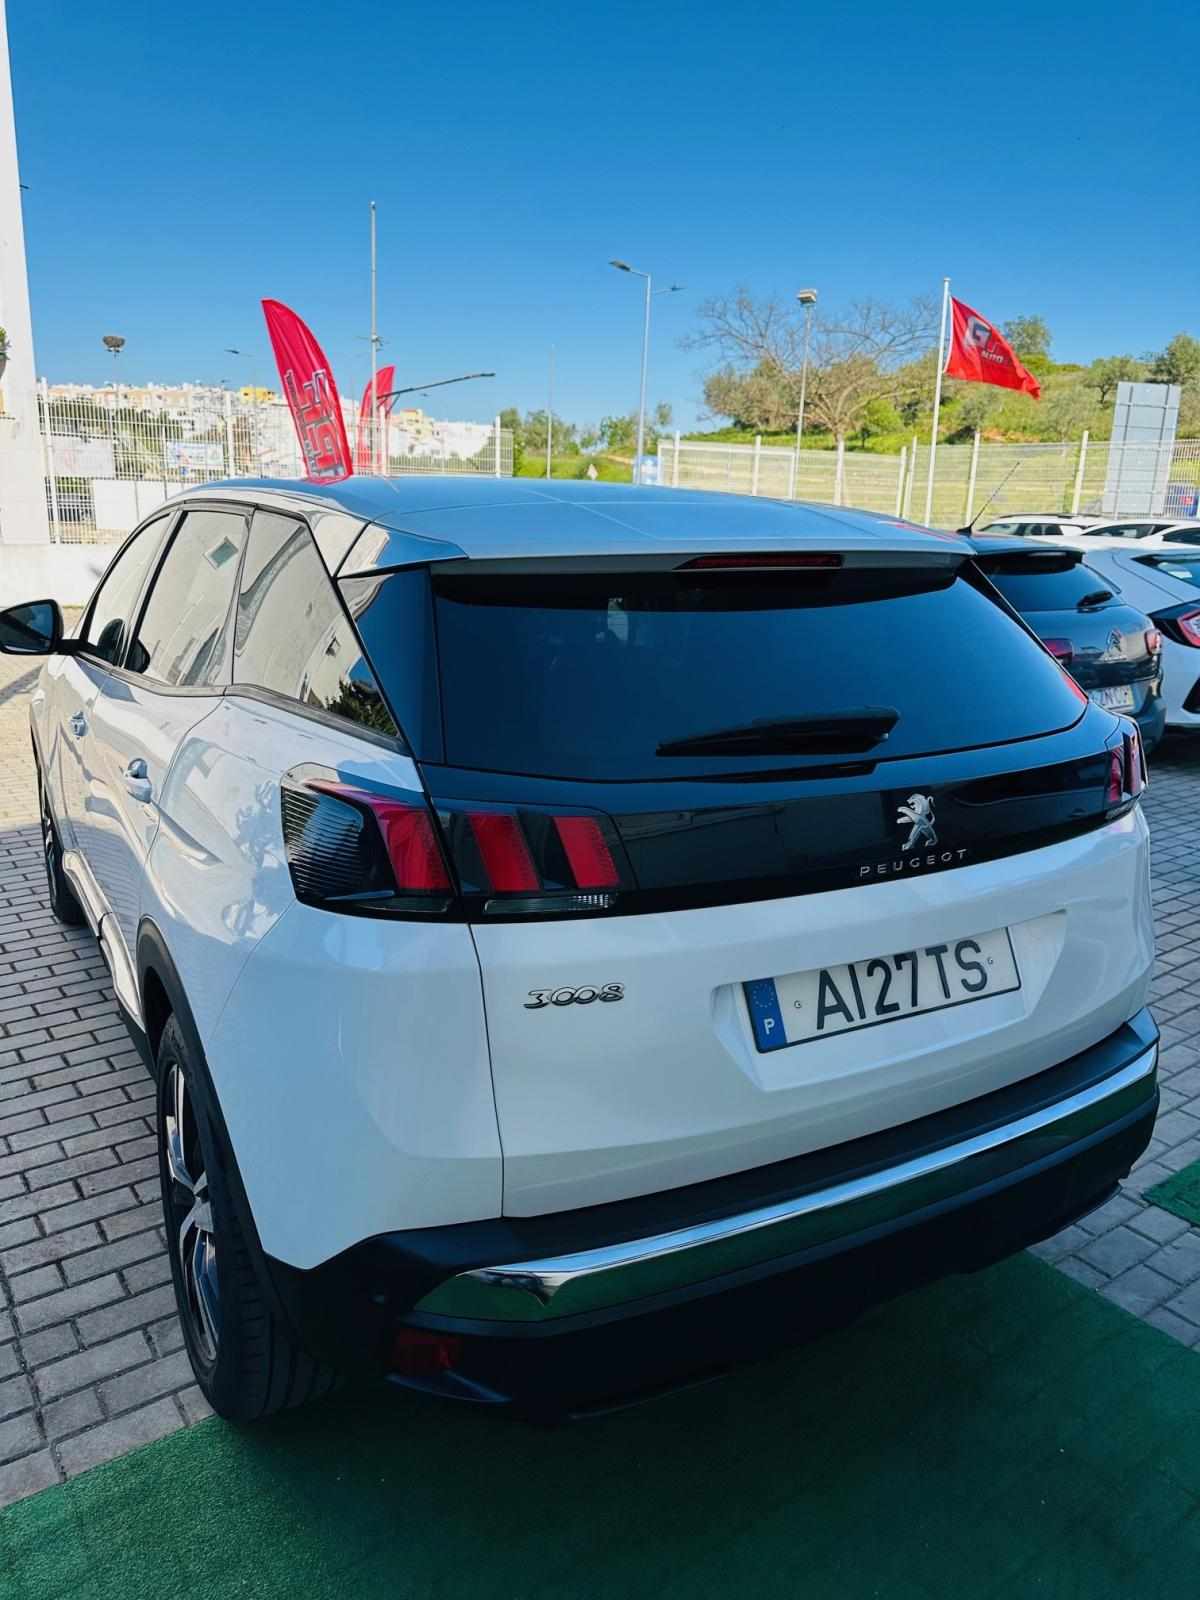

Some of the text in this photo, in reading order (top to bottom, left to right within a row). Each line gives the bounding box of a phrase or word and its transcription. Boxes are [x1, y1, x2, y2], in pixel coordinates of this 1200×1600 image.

[859, 848, 968, 877] PEUGEOT
[523, 983, 624, 1009] 3008
[763, 1018, 775, 1034] P
[816, 939, 988, 1030] AI27TS
